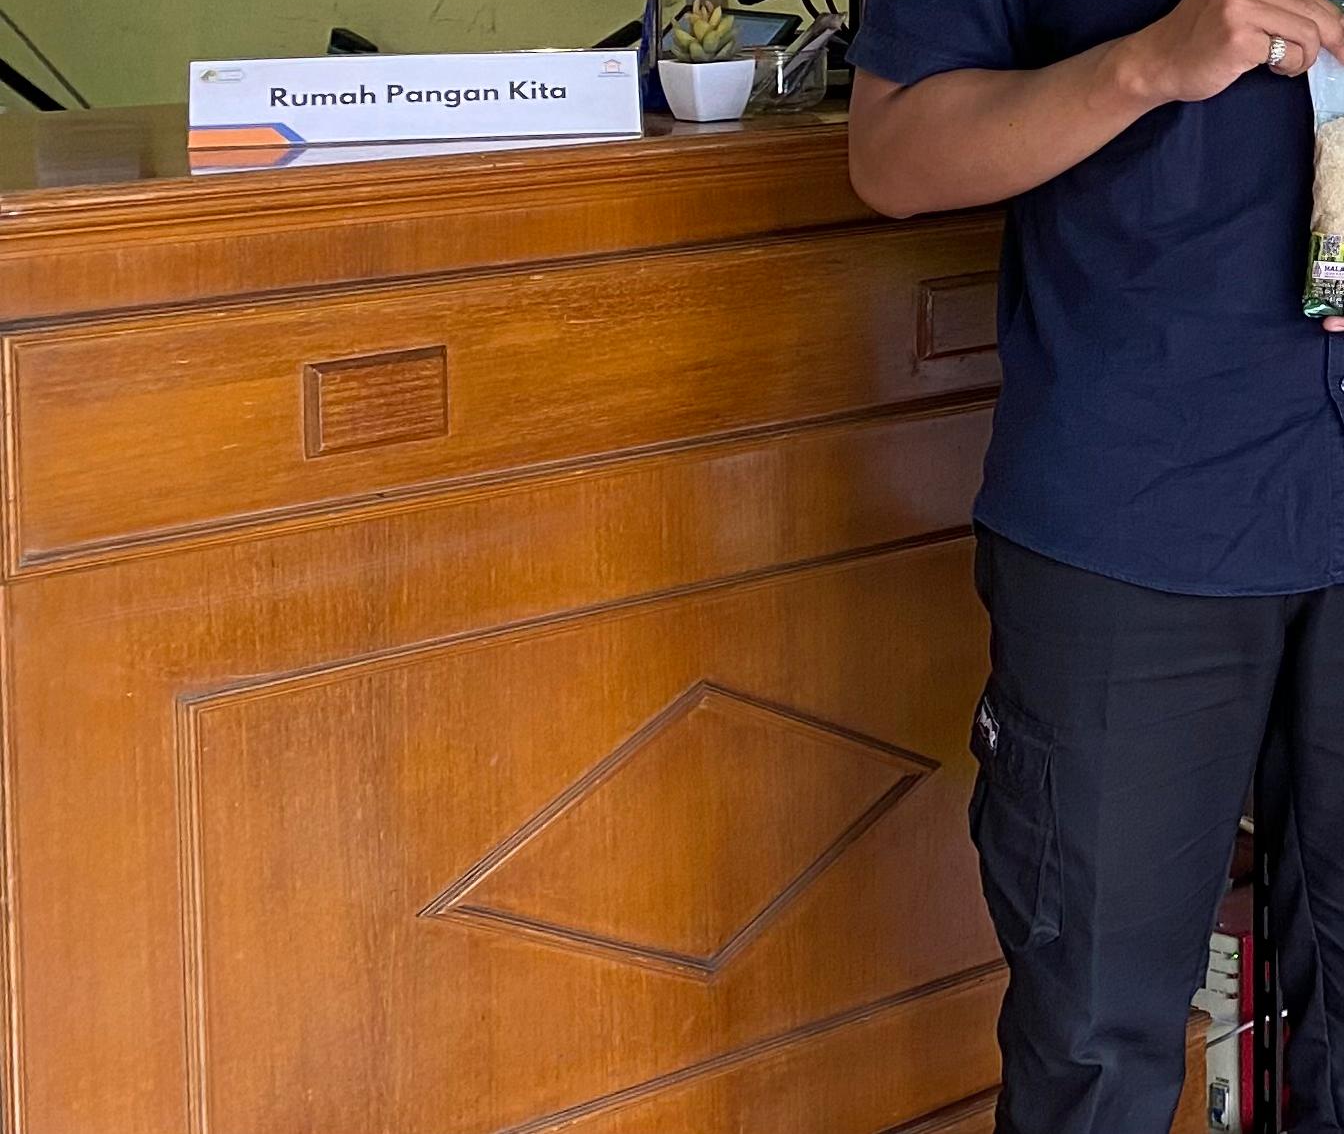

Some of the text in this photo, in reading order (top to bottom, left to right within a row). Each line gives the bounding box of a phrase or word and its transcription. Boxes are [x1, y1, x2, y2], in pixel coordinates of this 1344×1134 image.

[270, 80, 567, 108] Rumah Pangan Kita
